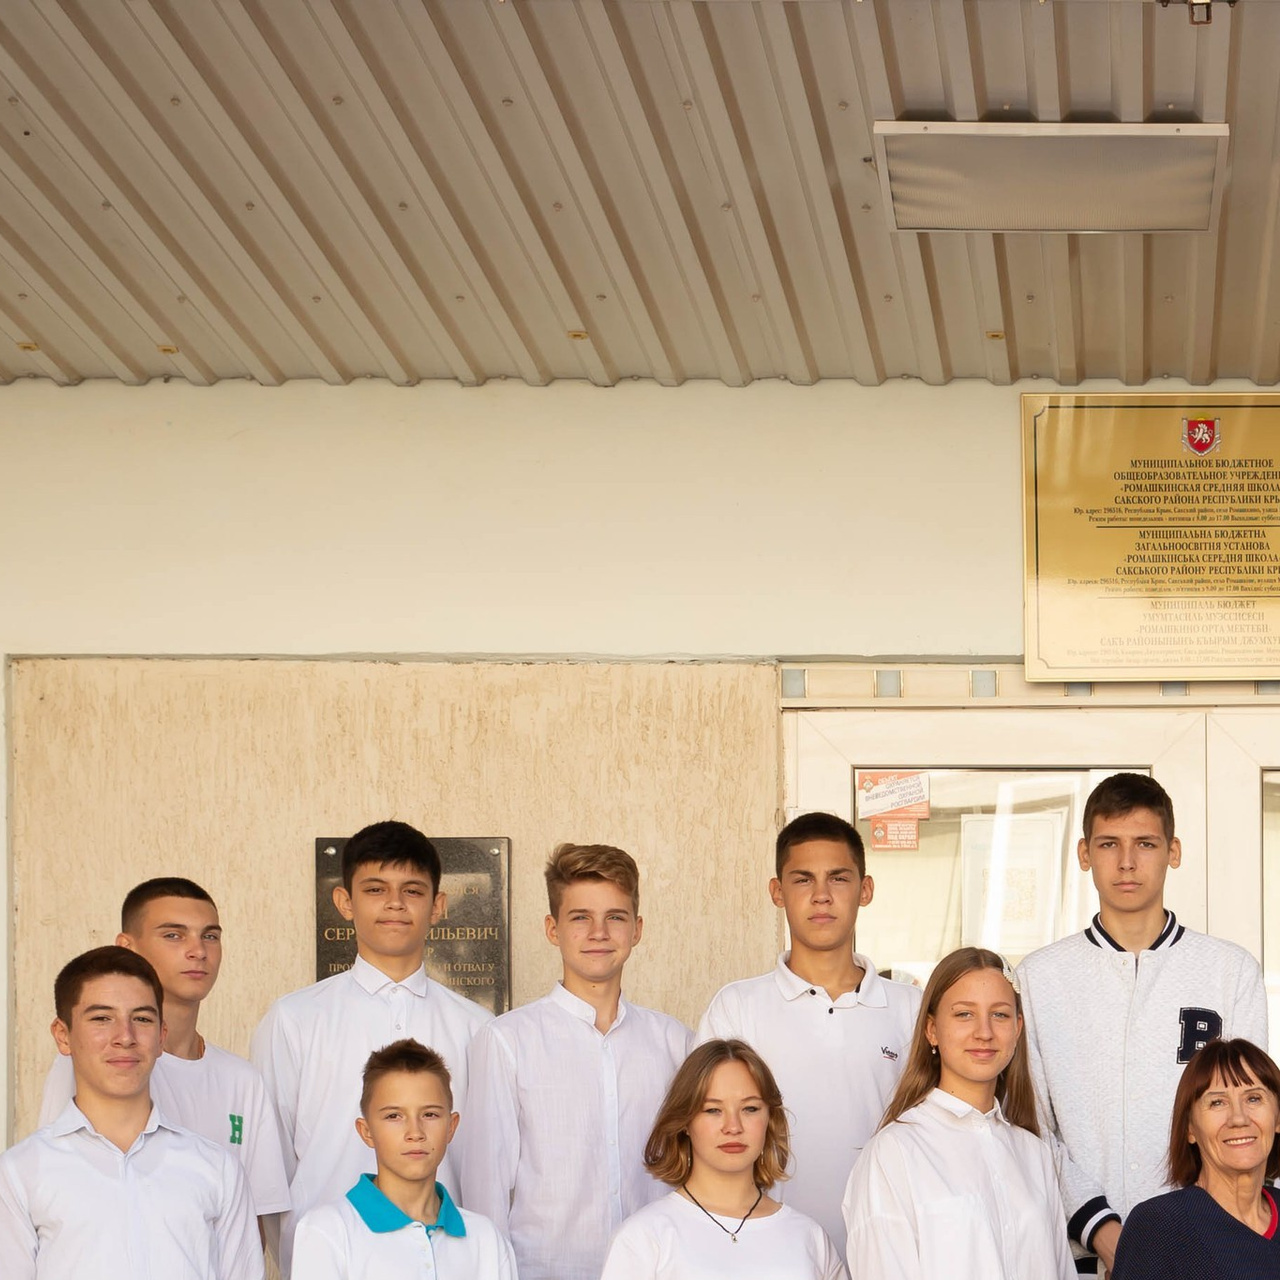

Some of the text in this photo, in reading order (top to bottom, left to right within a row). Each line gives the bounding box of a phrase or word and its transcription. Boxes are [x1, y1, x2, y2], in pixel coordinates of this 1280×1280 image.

[1130, 459, 1274, 469] МУНИЦИПАЛЬНОЕ БЮДЖЕТНОЕ
[1113, 471, 1228, 481] ОБЩЕОБРАЗОВАТЕЛЬНОЕ
[1203, 483, 1244, 493] СРЕДНЯЯ
[1114, 495, 1161, 504] САКСКОГО
[1164, 494, 1200, 504] РАЙОНА
[1202, 495, 1261, 504] РЕСПУБЛИКИ
[1214, 530, 1266, 539] БЮДЖЕТНА
[1135, 542, 1270, 551] ЗАГАЛЬНООСВІТНЯ УСТАНОВА
[1202, 554, 1243, 563] СЕРЕДНЯ
[1116, 566, 1168, 575] САКСЬКОГО
[1170, 565, 1207, 575] РАЙОНУ
[1209, 566, 1264, 575] РЕСПУБЛІКИ
[1150, 600, 1256, 610] МУНИЦИПАЛЬ БЮДЖЕТ
[1202, 624, 1224, 633] ОРТА
[1100, 637, 1124, 646] САКЪ
[324, 928, 498, 940] СЕР ИЛЬЕВИЧ
[454, 963, 494, 972] ОТВАГУ
